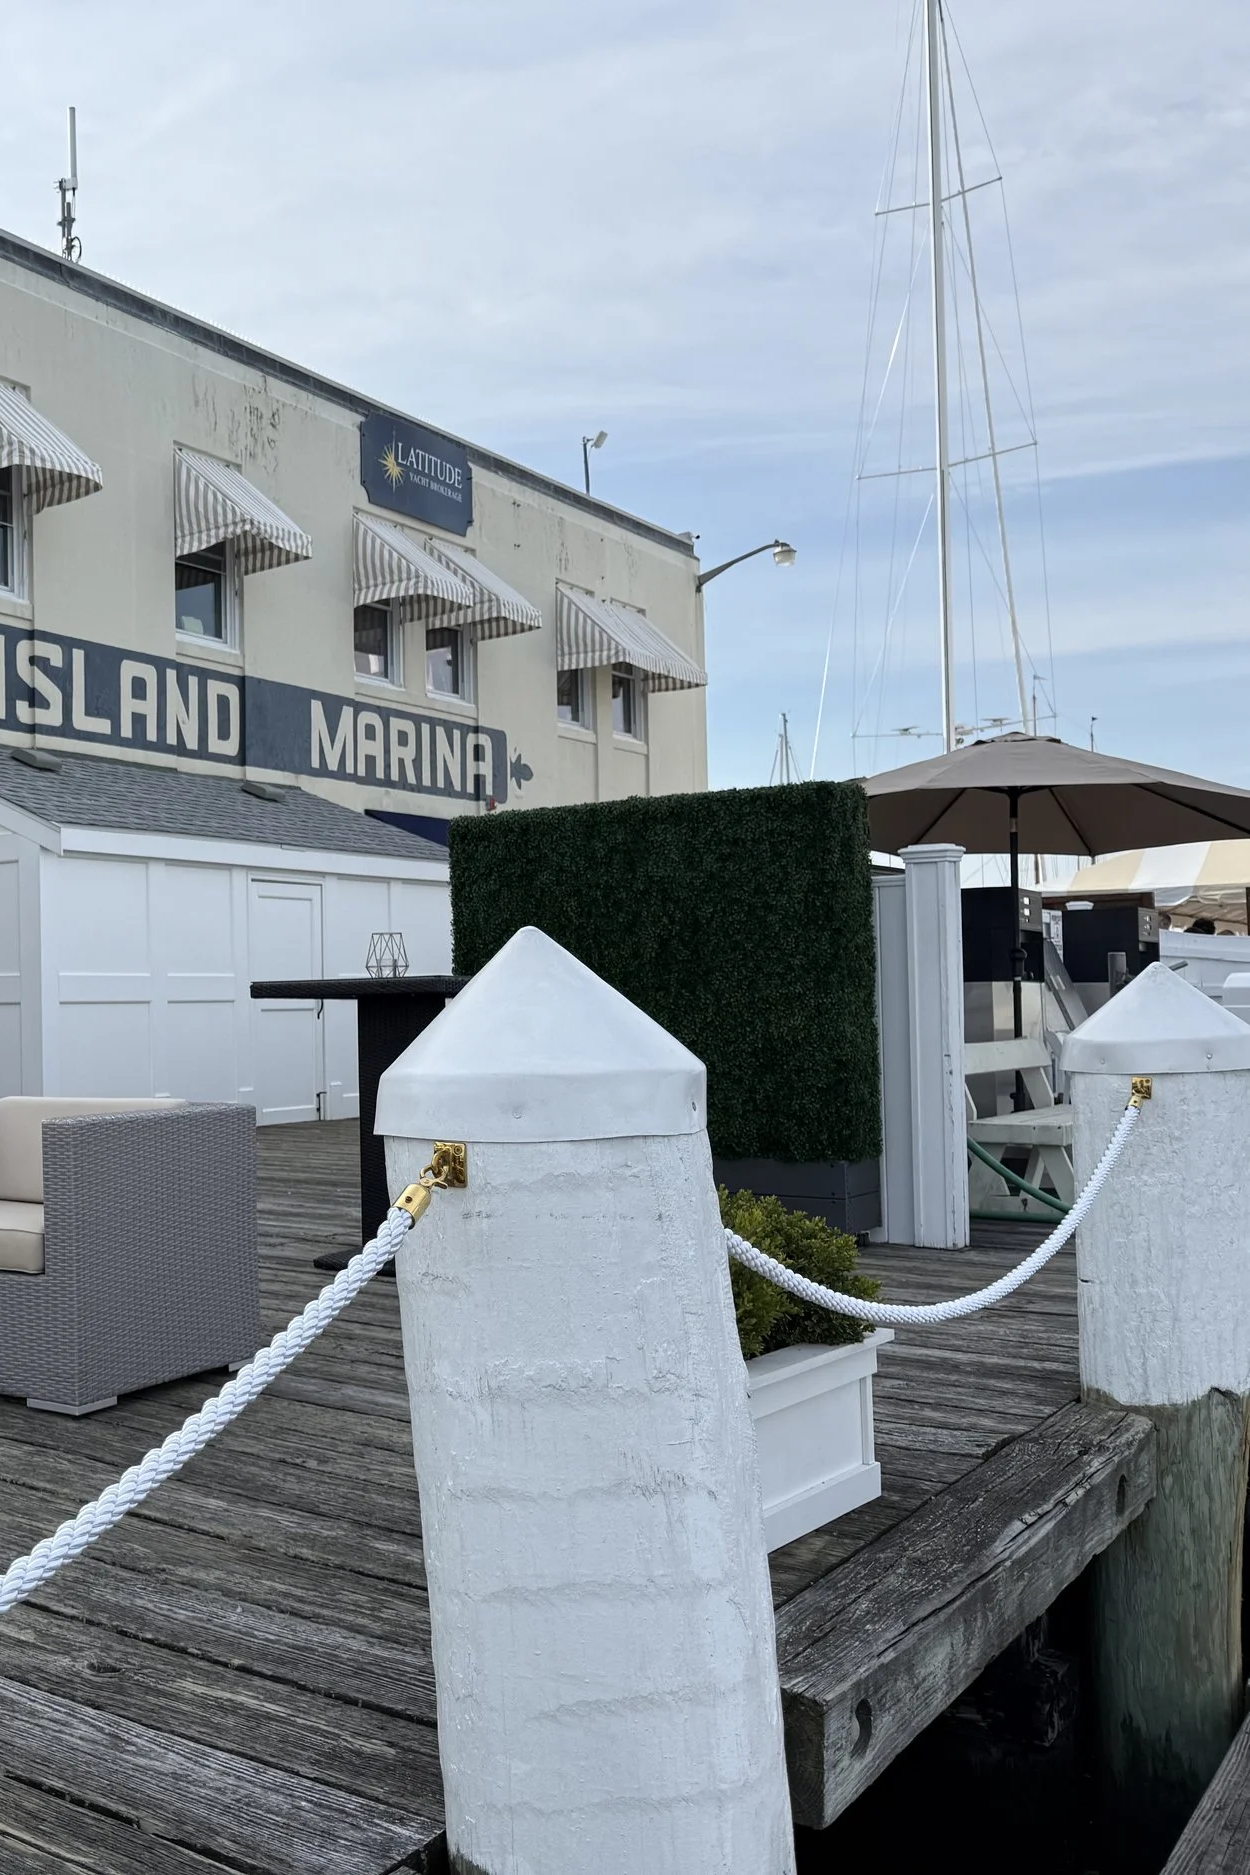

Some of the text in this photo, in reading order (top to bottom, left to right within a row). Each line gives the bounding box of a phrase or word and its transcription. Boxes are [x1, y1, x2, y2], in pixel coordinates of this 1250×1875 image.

[398, 442, 462, 489] LATITUDE
[409, 471, 462, 503] YACHT BROKERAGE
[311, 699, 493, 796] MARINA
